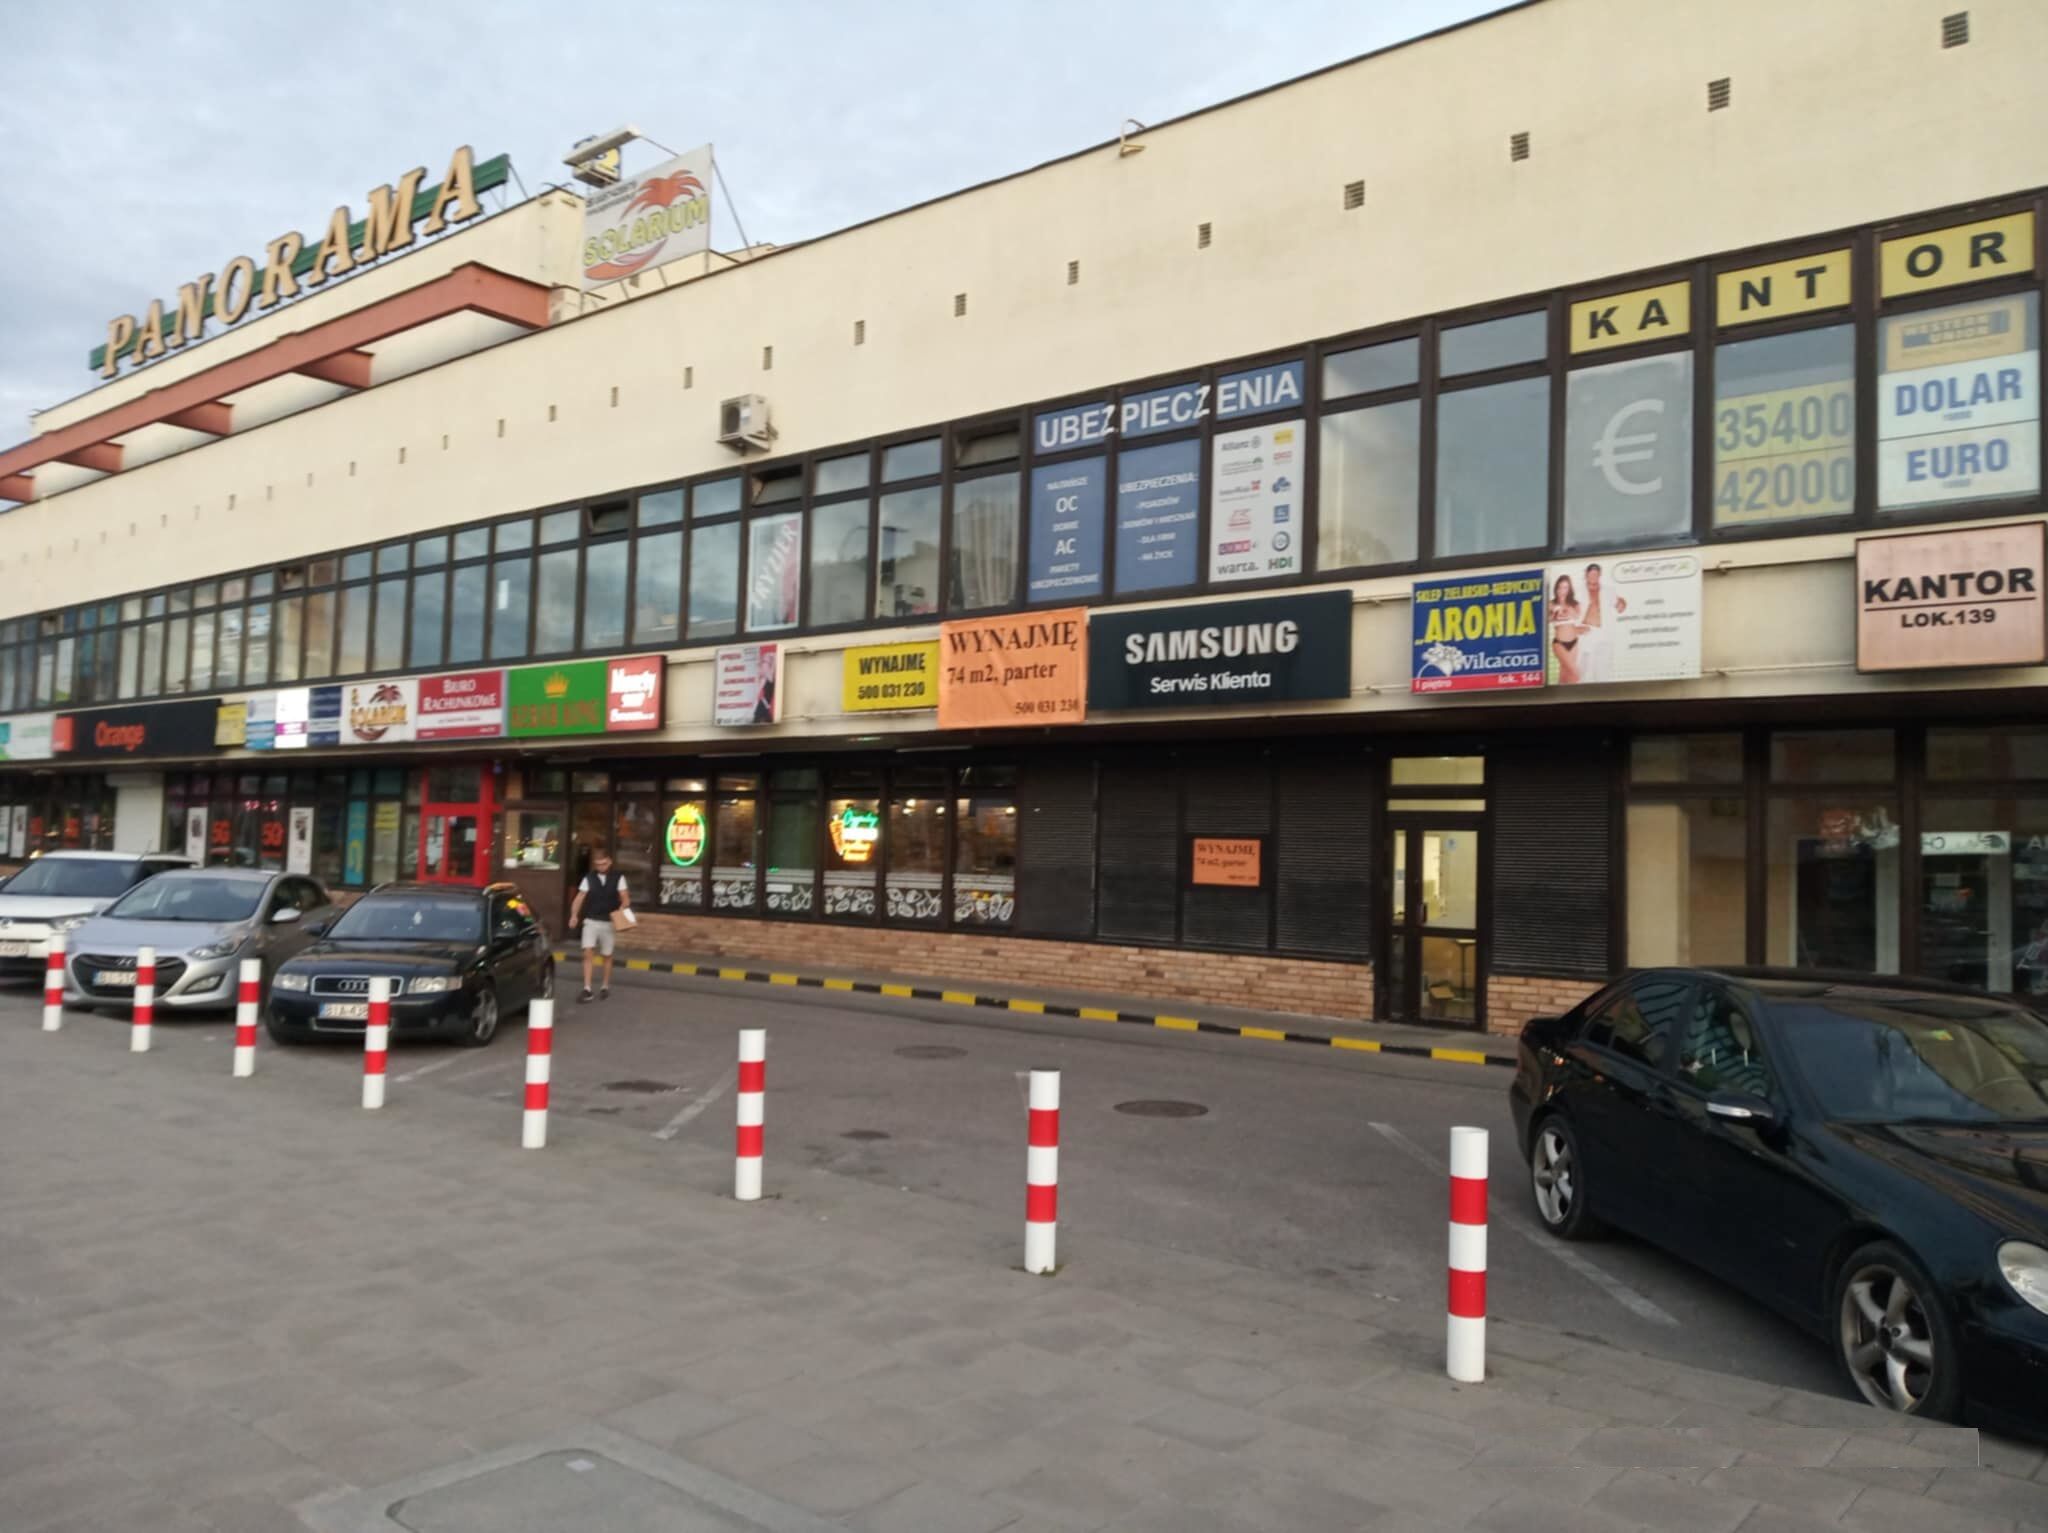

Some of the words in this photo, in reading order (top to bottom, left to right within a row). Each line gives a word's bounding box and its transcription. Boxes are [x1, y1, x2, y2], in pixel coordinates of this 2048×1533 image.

[584, 194, 709, 267] SOLARIUM
[102, 144, 483, 378] PANORAMA
[1895, 368, 2022, 416] DOLAR
[1039, 370, 1300, 448] UBEZPIECZENIA
[1718, 392, 1851, 451] 35400
[1906, 438, 2009, 482] EURO
[1716, 457, 1852, 513] 42000
[1056, 495, 1078, 513] OC
[1054, 537, 1076, 556] AC
[1864, 567, 2036, 604] KANTOR
[1901, 608, 1997, 629] LOK.139
[949, 620, 1078, 654] WYNAJMĘ
[1125, 620, 1299, 664] SAMSUNG
[859, 652, 926, 676] WYNAJMĘ
[948, 666, 965, 684] 74
[1003, 662, 1057, 687] parter
[1463, 651, 1539, 670] Vilcacora
[858, 685, 880, 700] 500
[882, 683, 901, 698] 031
[1151, 673, 1208, 693] Serwis
[1210, 670, 1272, 690] Klienta
[1015, 701, 1035, 715] 500
[95, 721, 145, 751] Orange
